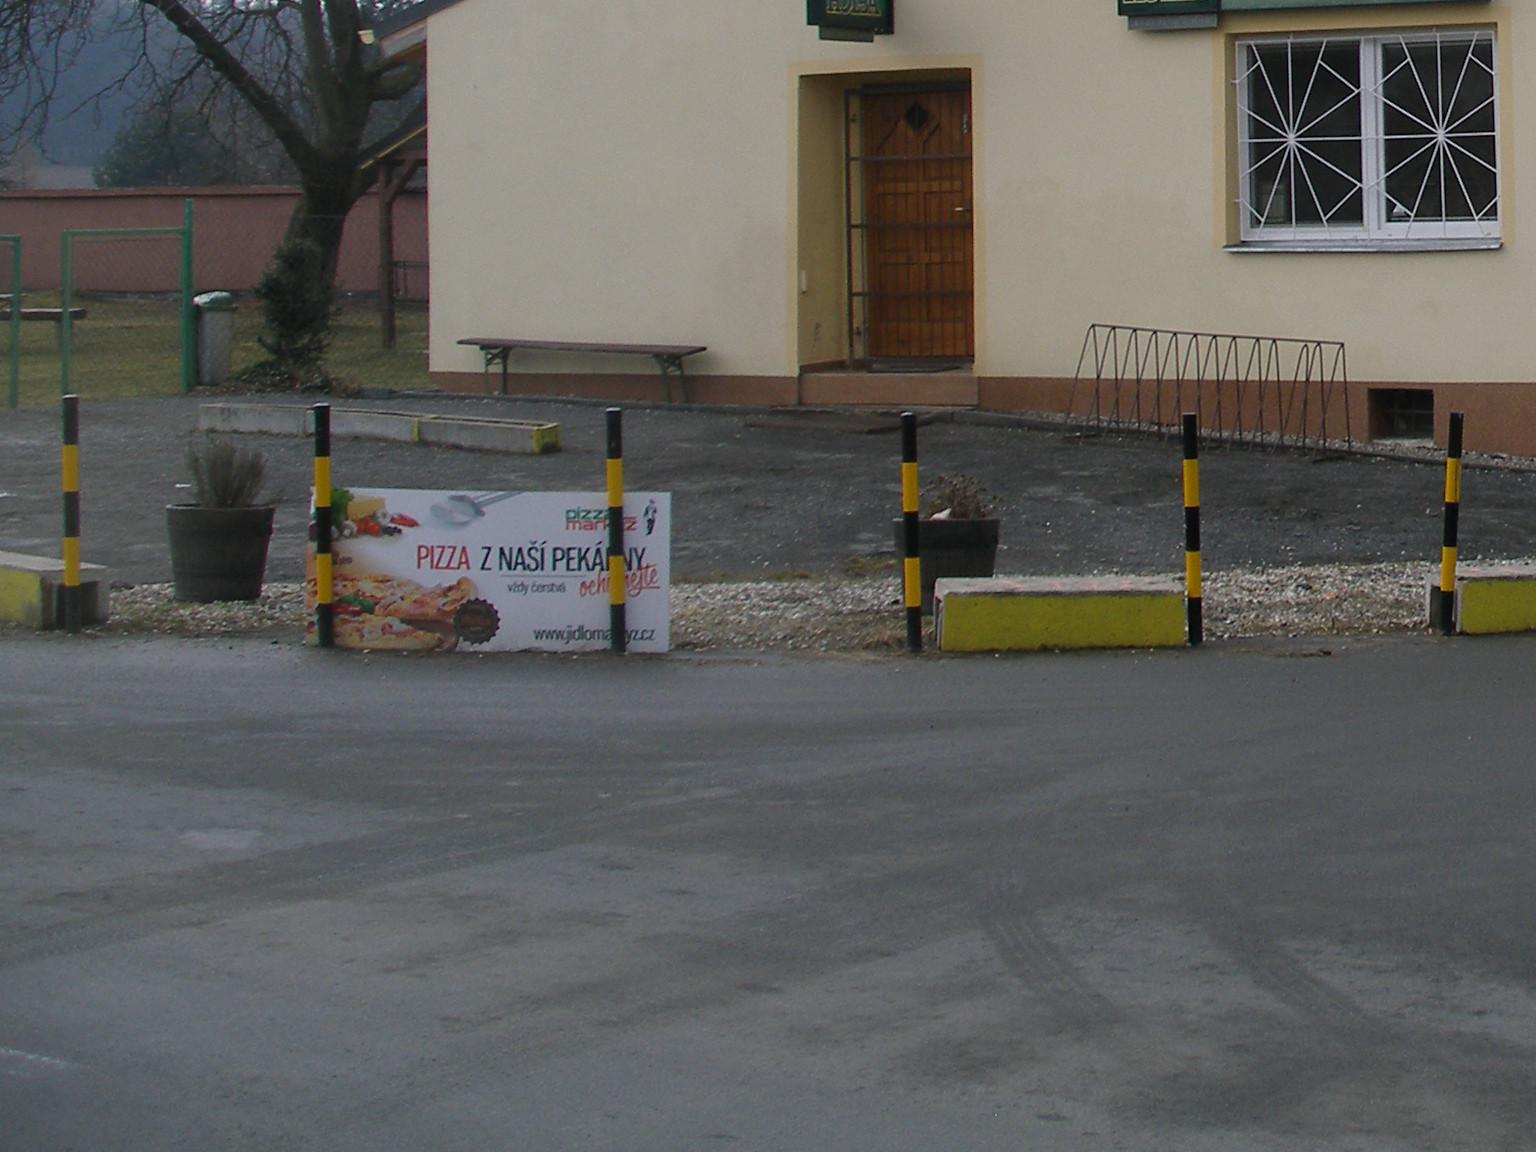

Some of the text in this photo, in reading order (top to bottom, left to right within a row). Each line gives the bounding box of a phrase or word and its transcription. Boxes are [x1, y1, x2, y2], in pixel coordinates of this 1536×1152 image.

[416, 540, 646, 572] PIZZA Z NAŠÍ PEKÁNY
